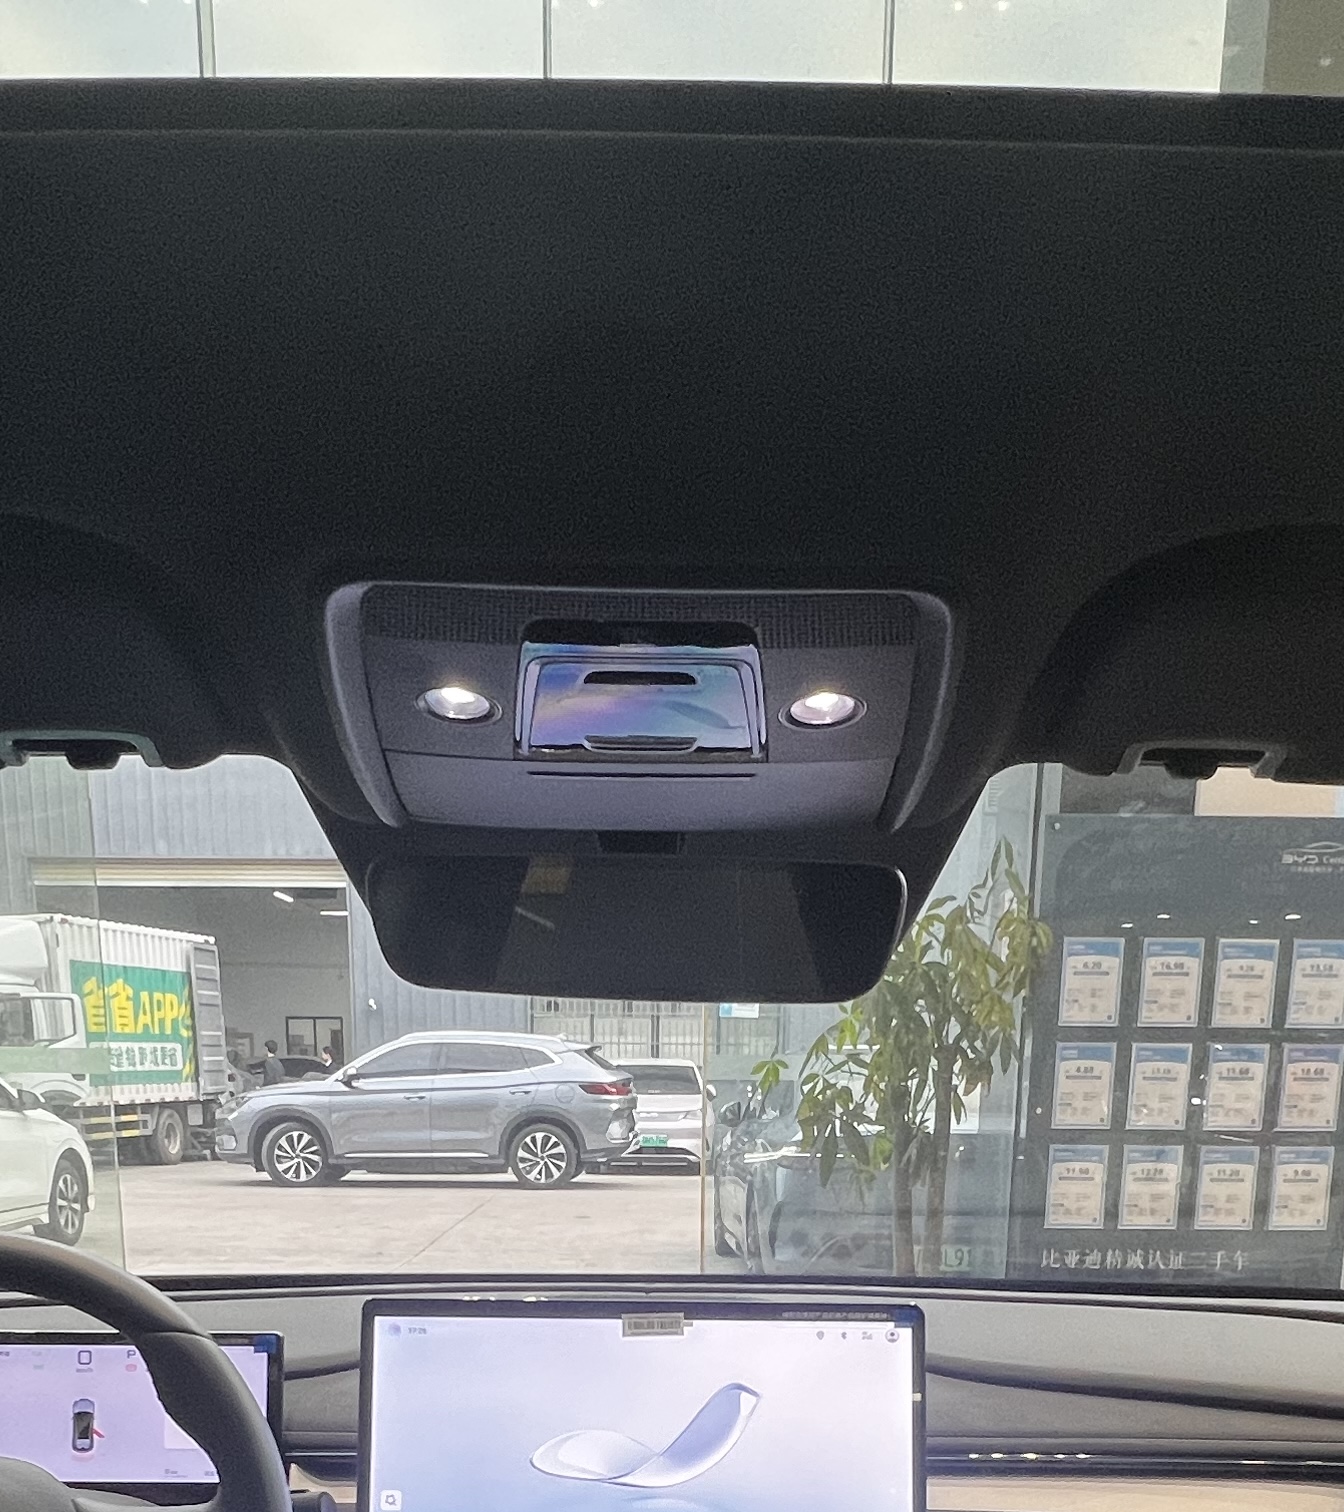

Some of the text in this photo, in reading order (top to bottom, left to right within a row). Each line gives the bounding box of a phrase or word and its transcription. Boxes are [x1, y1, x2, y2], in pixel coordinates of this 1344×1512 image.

[1040, 1248, 1250, 1271] 比亚迪精诚认证二手车
